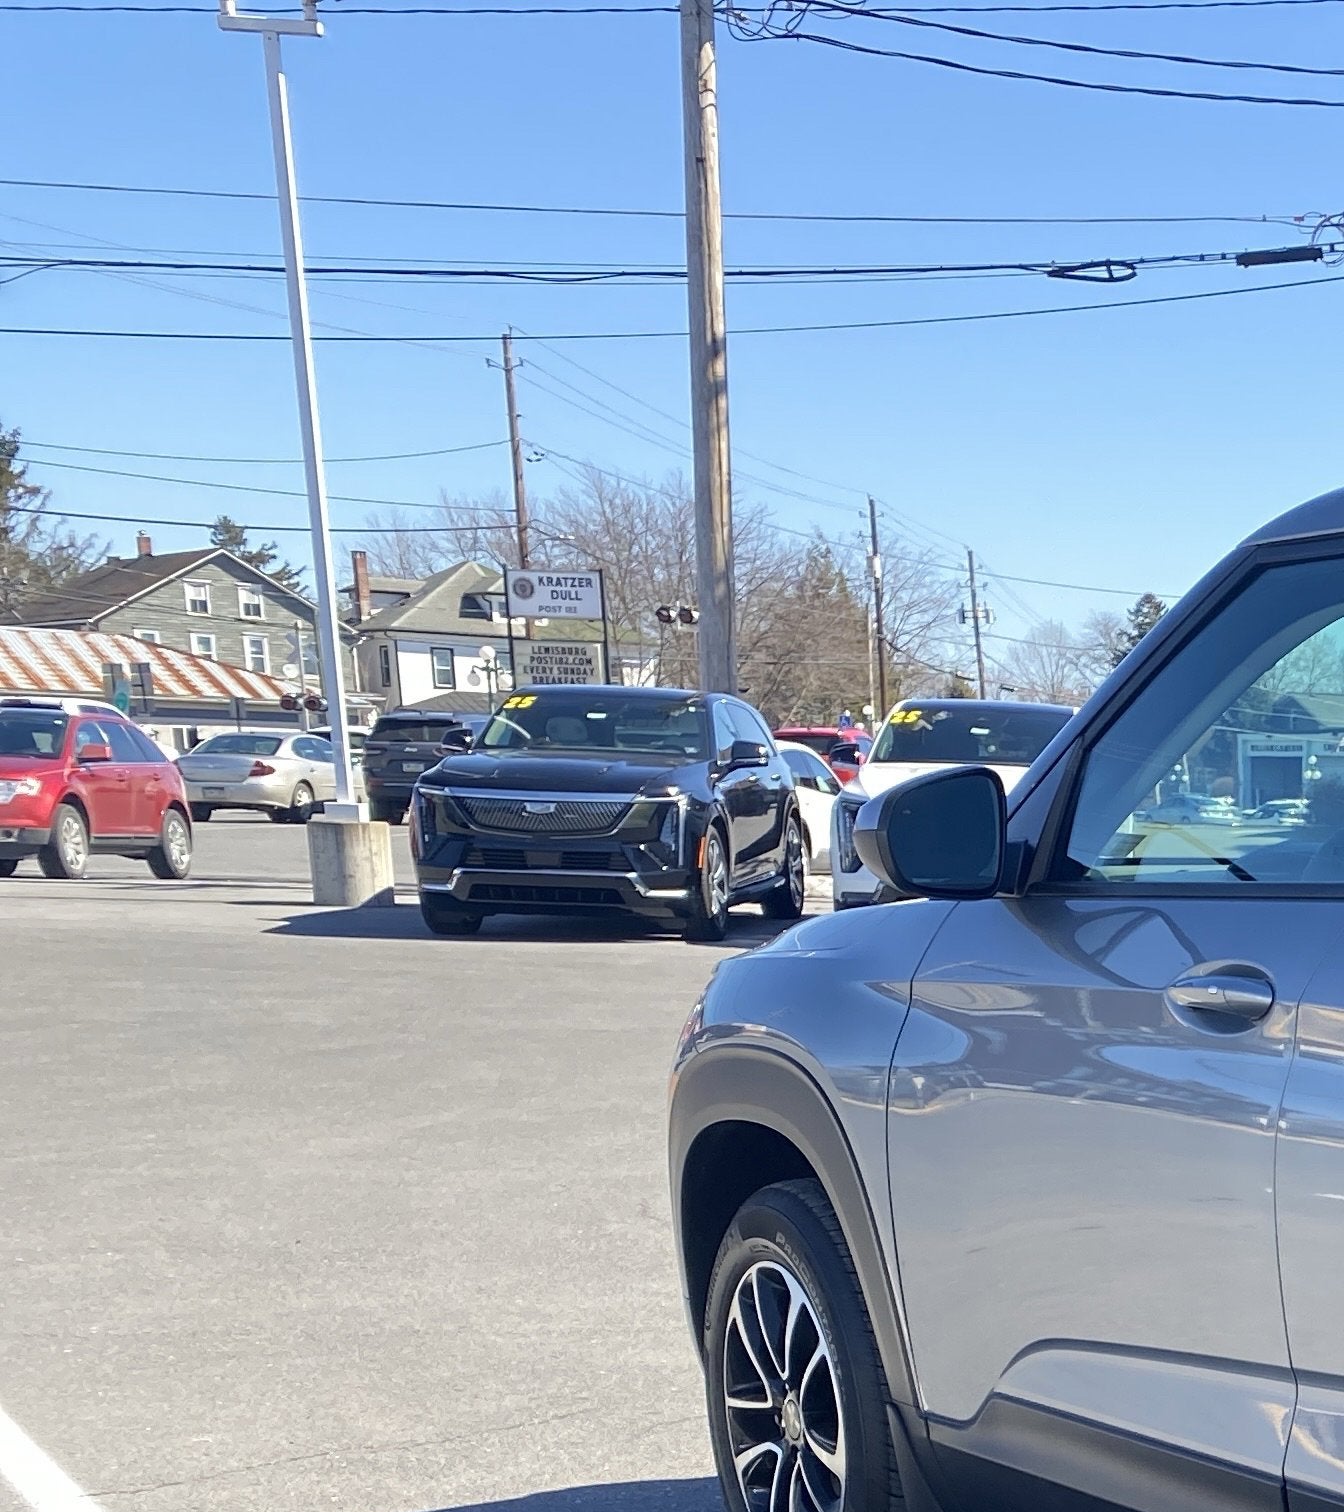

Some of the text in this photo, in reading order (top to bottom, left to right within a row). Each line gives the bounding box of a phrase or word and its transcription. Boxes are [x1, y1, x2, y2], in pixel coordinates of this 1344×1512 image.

[538, 576, 593, 589] KRATZER
[550, 590, 583, 601] DULL
[538, 605, 562, 613] POST
[531, 646, 587, 656] LEWISBURG
[523, 666, 595, 676] EVERY SUNDAY
[532, 676, 587, 685] BREAKFAST
[502, 696, 538, 709] 25
[890, 710, 923, 724] 25
